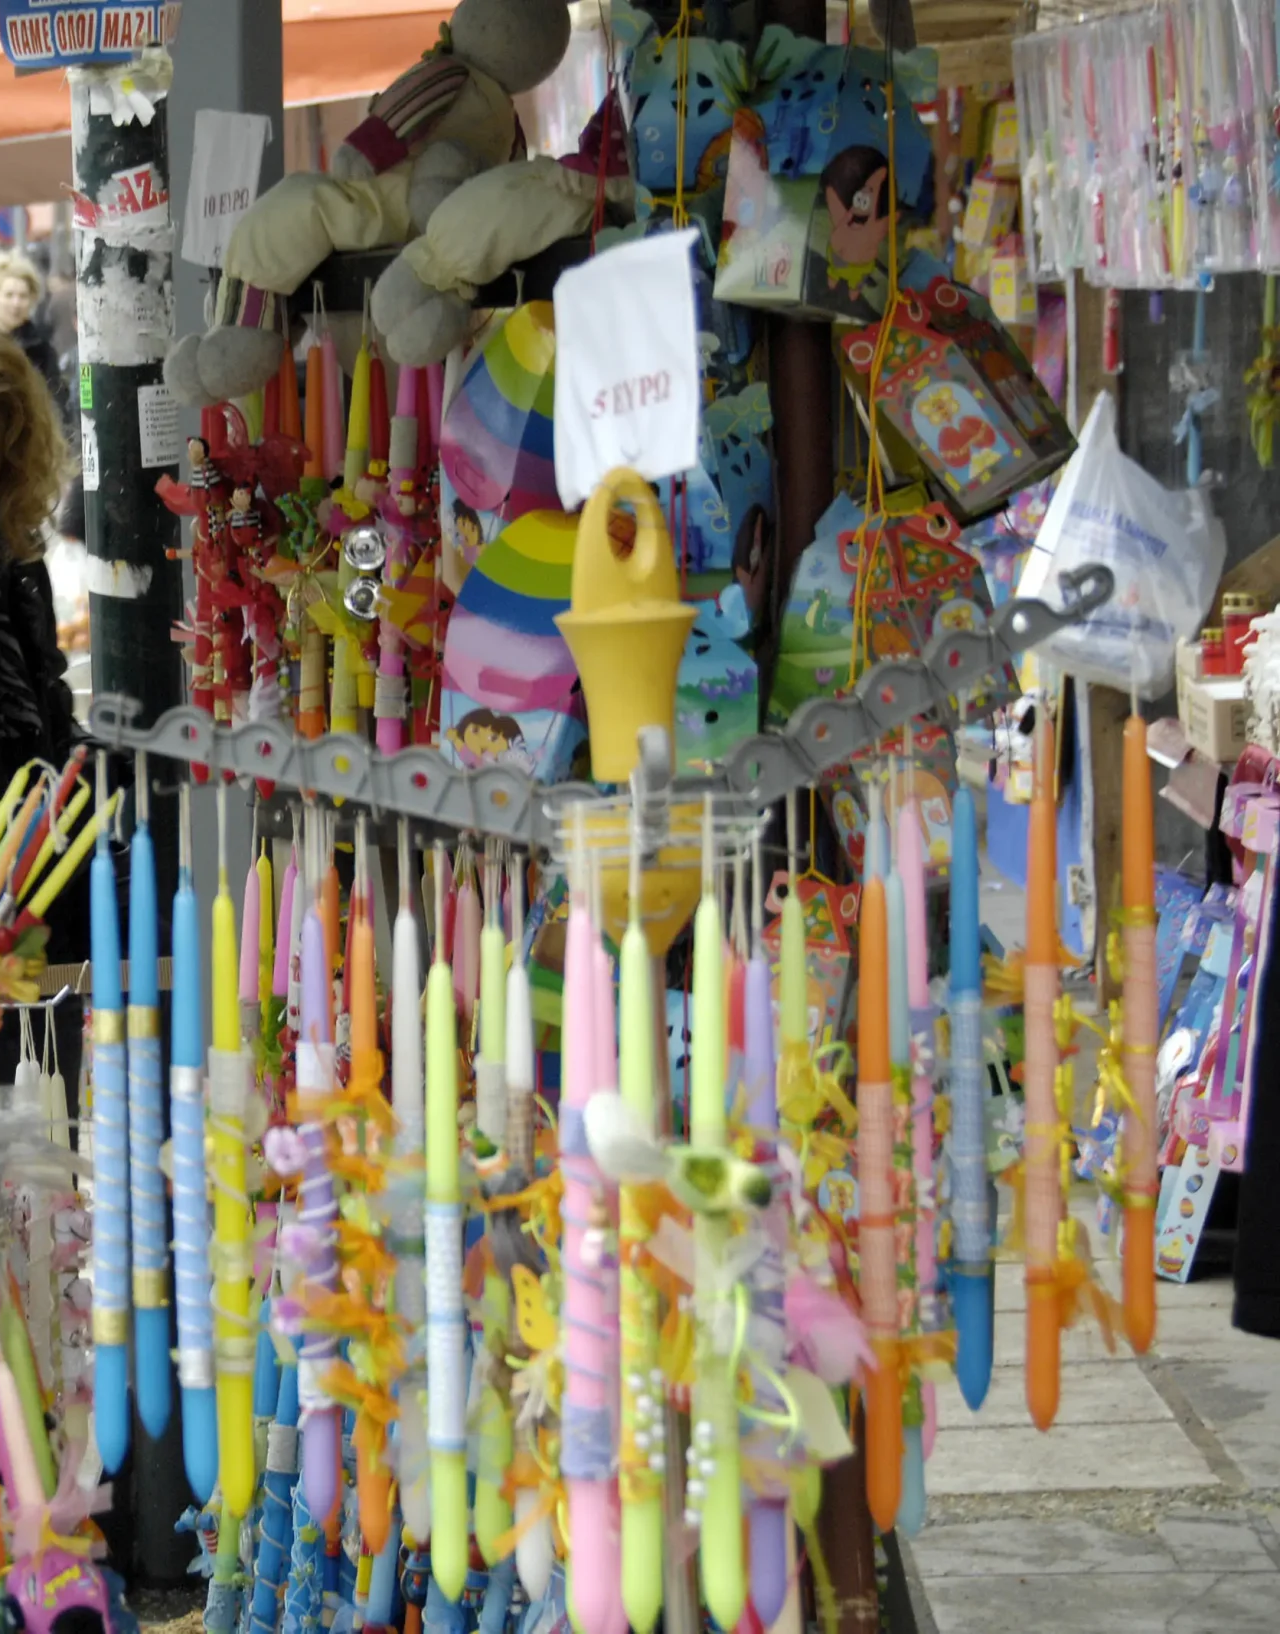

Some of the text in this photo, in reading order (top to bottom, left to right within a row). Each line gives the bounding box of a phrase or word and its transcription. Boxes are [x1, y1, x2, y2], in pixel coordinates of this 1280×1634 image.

[8, 18, 52, 56] ΠΑΜΕ
[56, 12, 94, 51] ΟΛΟΙ
[103, 9, 152, 48] ΜΑΖΙ
[203, 188, 250, 219] 10 ΕΥΡΩ
[590, 369, 671, 420] 5 ΕΥΡΩ
